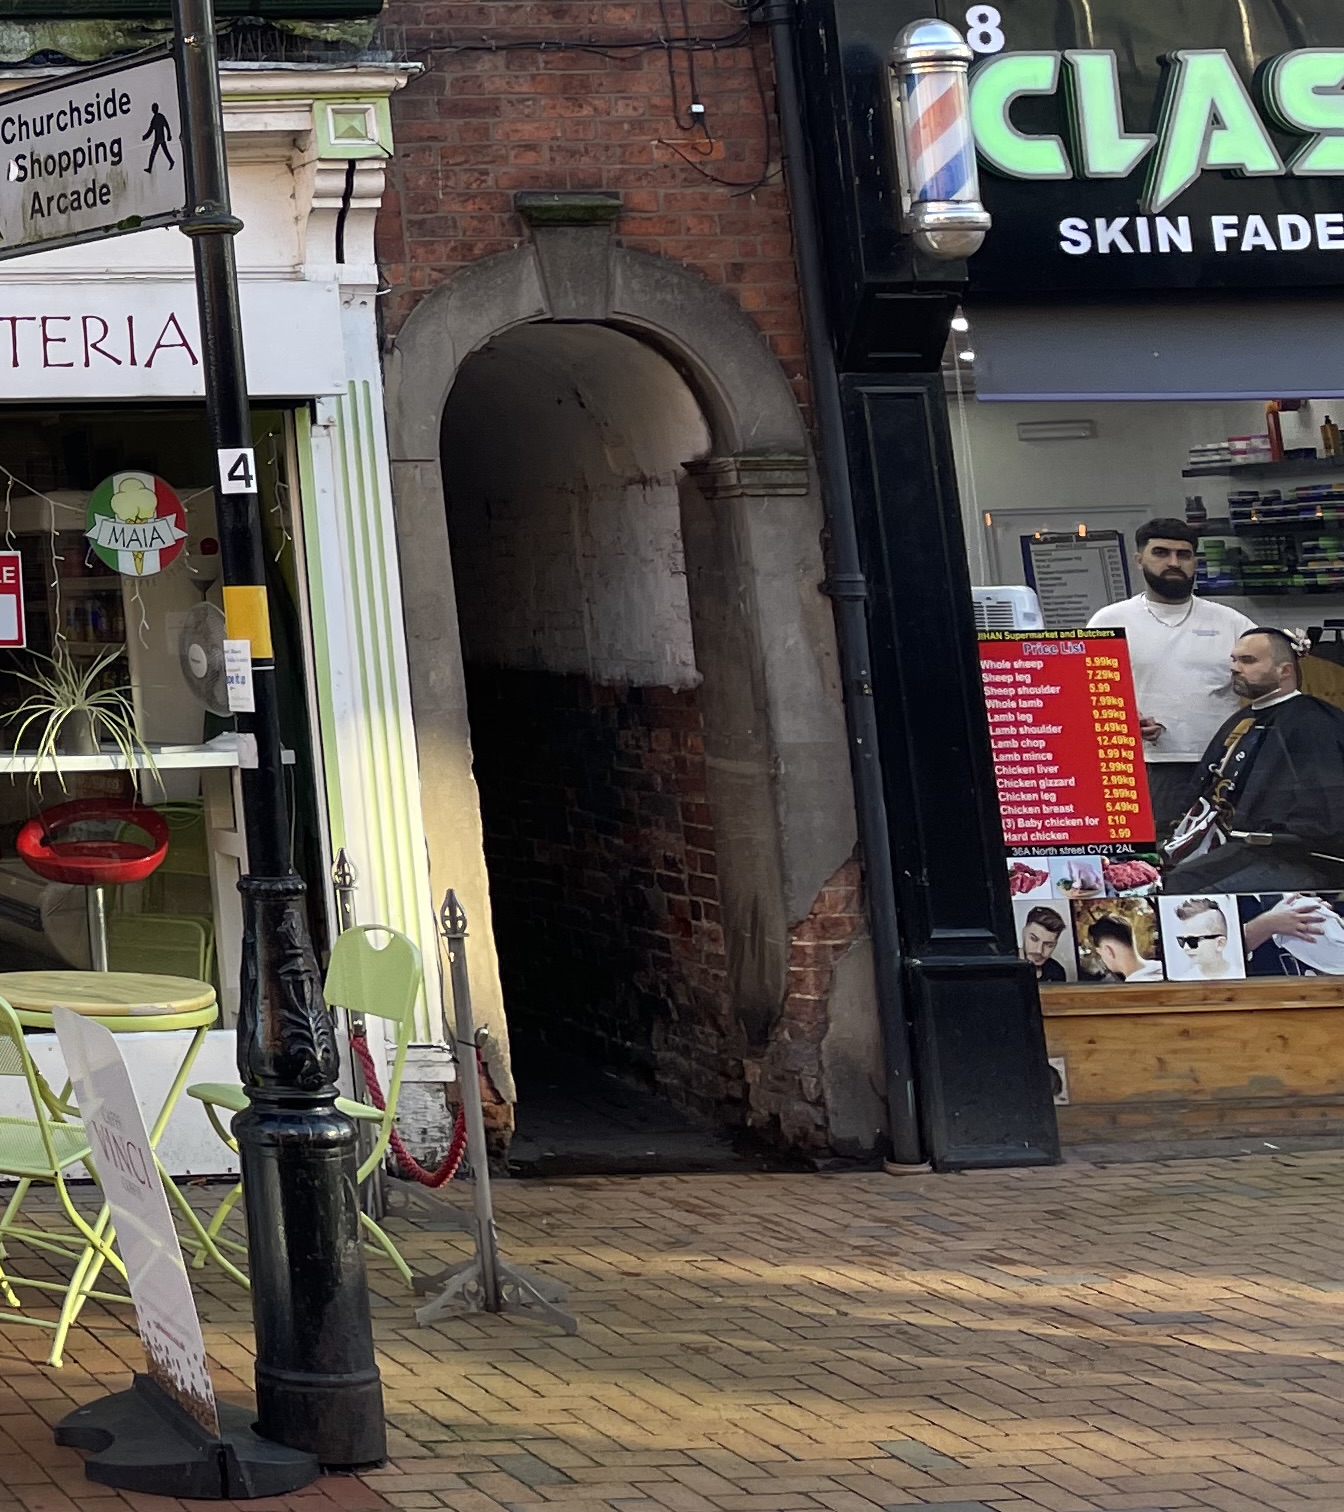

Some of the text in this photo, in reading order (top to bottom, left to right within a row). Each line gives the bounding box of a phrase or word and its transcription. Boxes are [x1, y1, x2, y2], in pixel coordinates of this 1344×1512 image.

[965, 4, 1005, 54] 8
[1, 88, 131, 144] Churchside
[14, 137, 122, 182] Shopping
[30, 179, 111, 220] Arcade
[1059, 214, 1193, 255] SKIN
[228, 453, 253, 488] 4
[108, 525, 165, 549] MAIA
[1004, 630, 1058, 641] Supermarket
[1060, 630, 1076, 638] and
[1077, 629, 1115, 638] Butchers
[1023, 641, 1086, 655] Price List
[980, 660, 1011, 669] Whole
[1013, 659, 1044, 670] sheep
[982, 673, 1013, 684] Sheep
[1015, 672, 1031, 684] leg
[984, 687, 1015, 697] Sheep
[1017, 685, 1061, 695] shoulder
[985, 700, 1016, 709] Whole
[1018, 699, 1044, 708] lamb
[988, 713, 1014, 722] Lamb
[1016, 712, 1033, 723] leg
[989, 726, 1016, 735] Lamb
[1018, 724, 1062, 734] shoulder
[991, 739, 1018, 749] Lamb
[1020, 739, 1046, 749] chop
[993, 752, 1020, 761] Lamb
[1023, 751, 1053, 761] mince
[994, 765, 1035, 775] Chicken
[1036, 764, 1059, 774] liver
[996, 779, 1037, 788] Chicken
[1039, 777, 1075, 789] gizzard
[998, 792, 1039, 802] Chicken
[1041, 791, 1057, 803] leg
[1000, 805, 1041, 815] Chicken
[1042, 804, 1074, 814] breast
[1017, 818, 1042, 830] Baby
[1044, 817, 1083, 827] chicken
[1085, 816, 1099, 826] for
[1003, 832, 1028, 842] Hard
[1030, 830, 1069, 841] chicken
[1032, 846, 1057, 856] North
[1059, 845, 1085, 855] street
[1087, 844, 1113, 854] CV21
[1116, 843, 1135, 853] 2AL
[92, 1120, 152, 1189] VINCI
